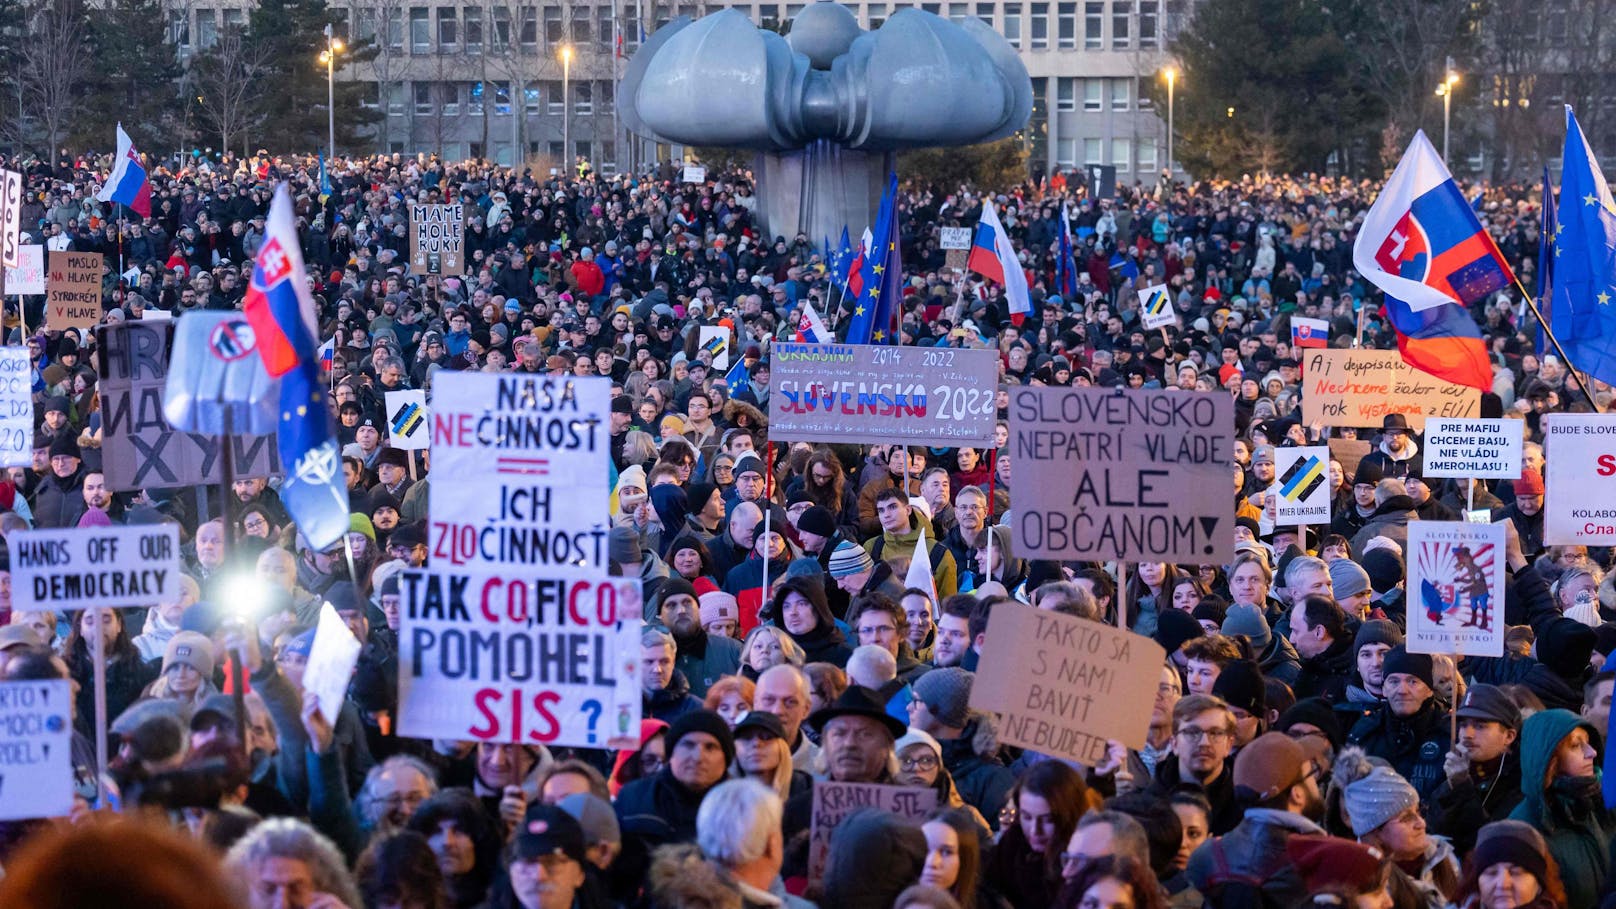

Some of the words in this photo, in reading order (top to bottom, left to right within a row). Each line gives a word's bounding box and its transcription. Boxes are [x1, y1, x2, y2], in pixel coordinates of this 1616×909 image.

[418, 223, 461, 239] HOLE
[418, 239, 462, 252] RUKY
[68, 257, 98, 269] MASLO
[52, 272, 64, 282] NA
[68, 272, 98, 284] HLAVE
[52, 288, 97, 303] SYROKRÉM
[56, 307, 63, 317] V
[67, 307, 97, 318] HLAVE
[777, 345, 854, 362] UKRAJINA
[923, 351, 954, 367] 2022
[780, 380, 927, 418] SLOVENSKO
[1315, 380, 1389, 395] Nechceme
[1017, 391, 1215, 428] SLOVENSKO
[1322, 400, 1347, 417] rok
[434, 410, 601, 452] NEČINNOSŤ
[1430, 436, 1475, 445] CHCEME
[1478, 437, 1509, 446] BASU,
[1441, 424, 1462, 432] PRE
[1465, 425, 1500, 433] MAFIU
[1551, 426, 1581, 434] BUDE
[1018, 428, 1124, 461] NEPATRÍ
[1144, 431, 1230, 466] VLÁDE,
[1440, 449, 1458, 457] NIE
[1462, 447, 1499, 458] VLÁDU
[1429, 461, 1502, 471] SMEROHLASU
[1073, 469, 1169, 507] ALE
[501, 485, 551, 522] ICH
[1280, 507, 1295, 516] MIER
[1297, 506, 1328, 516] UKRAJINE
[433, 517, 606, 566] ZLOČINNOSŤ
[1022, 506, 1219, 556] OBČANOM!
[1425, 532, 1489, 540] SLOVENSKO
[18, 540, 71, 568] HANDS
[87, 537, 118, 564] OFF
[140, 534, 171, 561] OUR
[34, 570, 167, 601] DEMOCRACY
[403, 572, 471, 622] TAK
[1034, 614, 1100, 653] TAKTO
[1109, 636, 1131, 664] SA
[1417, 633, 1435, 641] NIE
[413, 627, 616, 687] POMOHEL
[1031, 650, 1048, 676] S
[1057, 658, 1115, 694] NAMI
[469, 688, 562, 743] SIS
[1026, 684, 1094, 722] BAVIŤ
[1004, 713, 1105, 763] NEBUDETE
